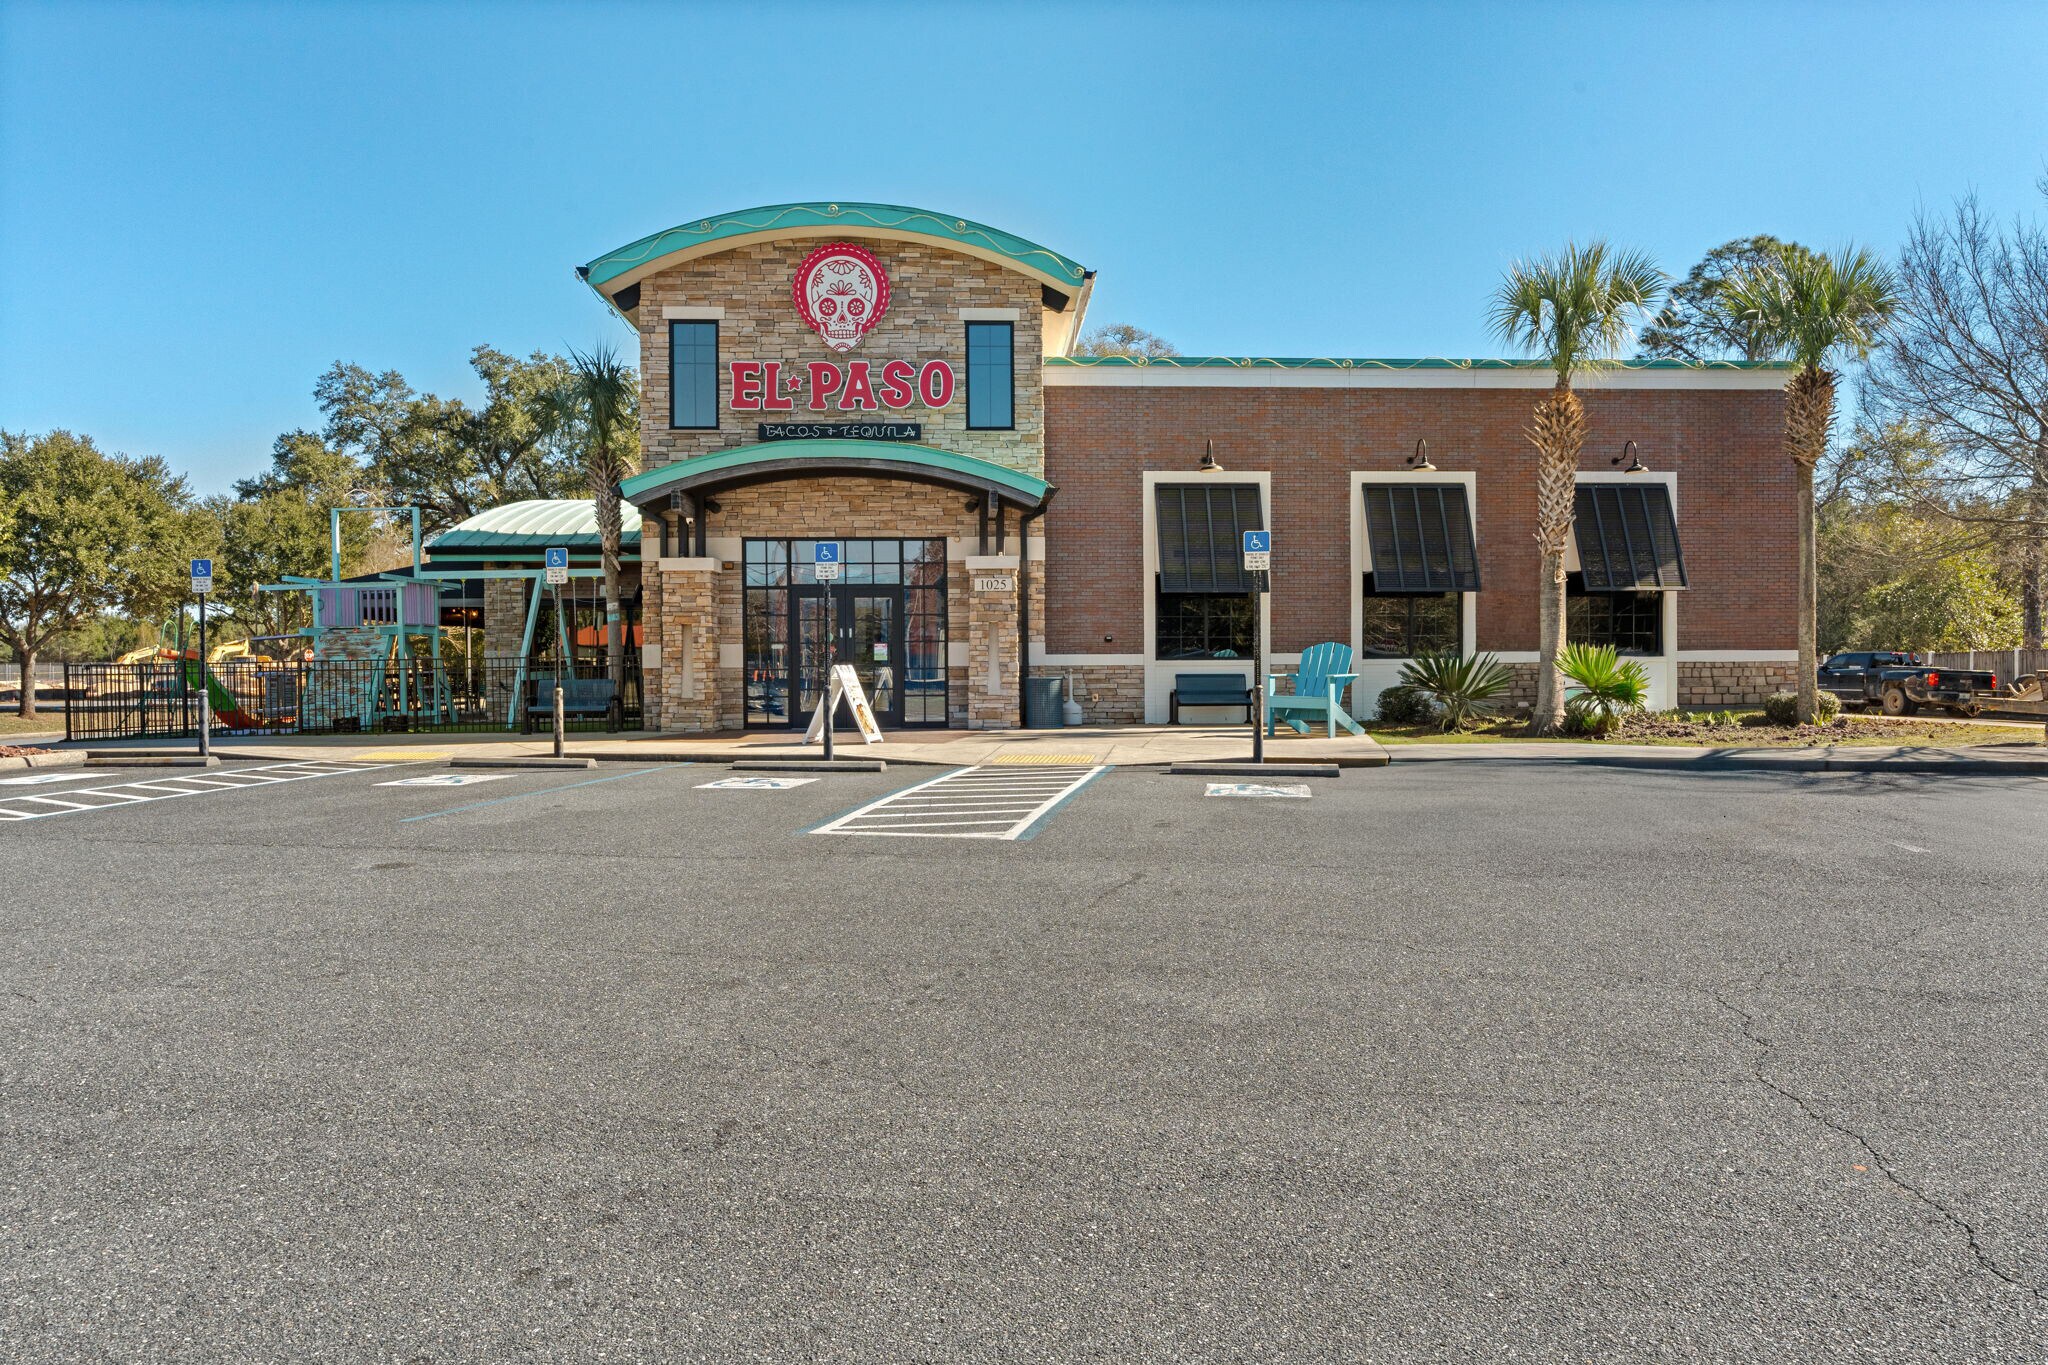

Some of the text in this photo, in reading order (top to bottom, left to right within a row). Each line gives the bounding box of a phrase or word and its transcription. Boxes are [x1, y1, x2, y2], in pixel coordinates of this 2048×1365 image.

[730, 360, 955, 410] EL PASO
[764, 425, 820, 438] TACOS
[839, 425, 916, 438] TEQUILA
[981, 579, 1007, 590] 1025
